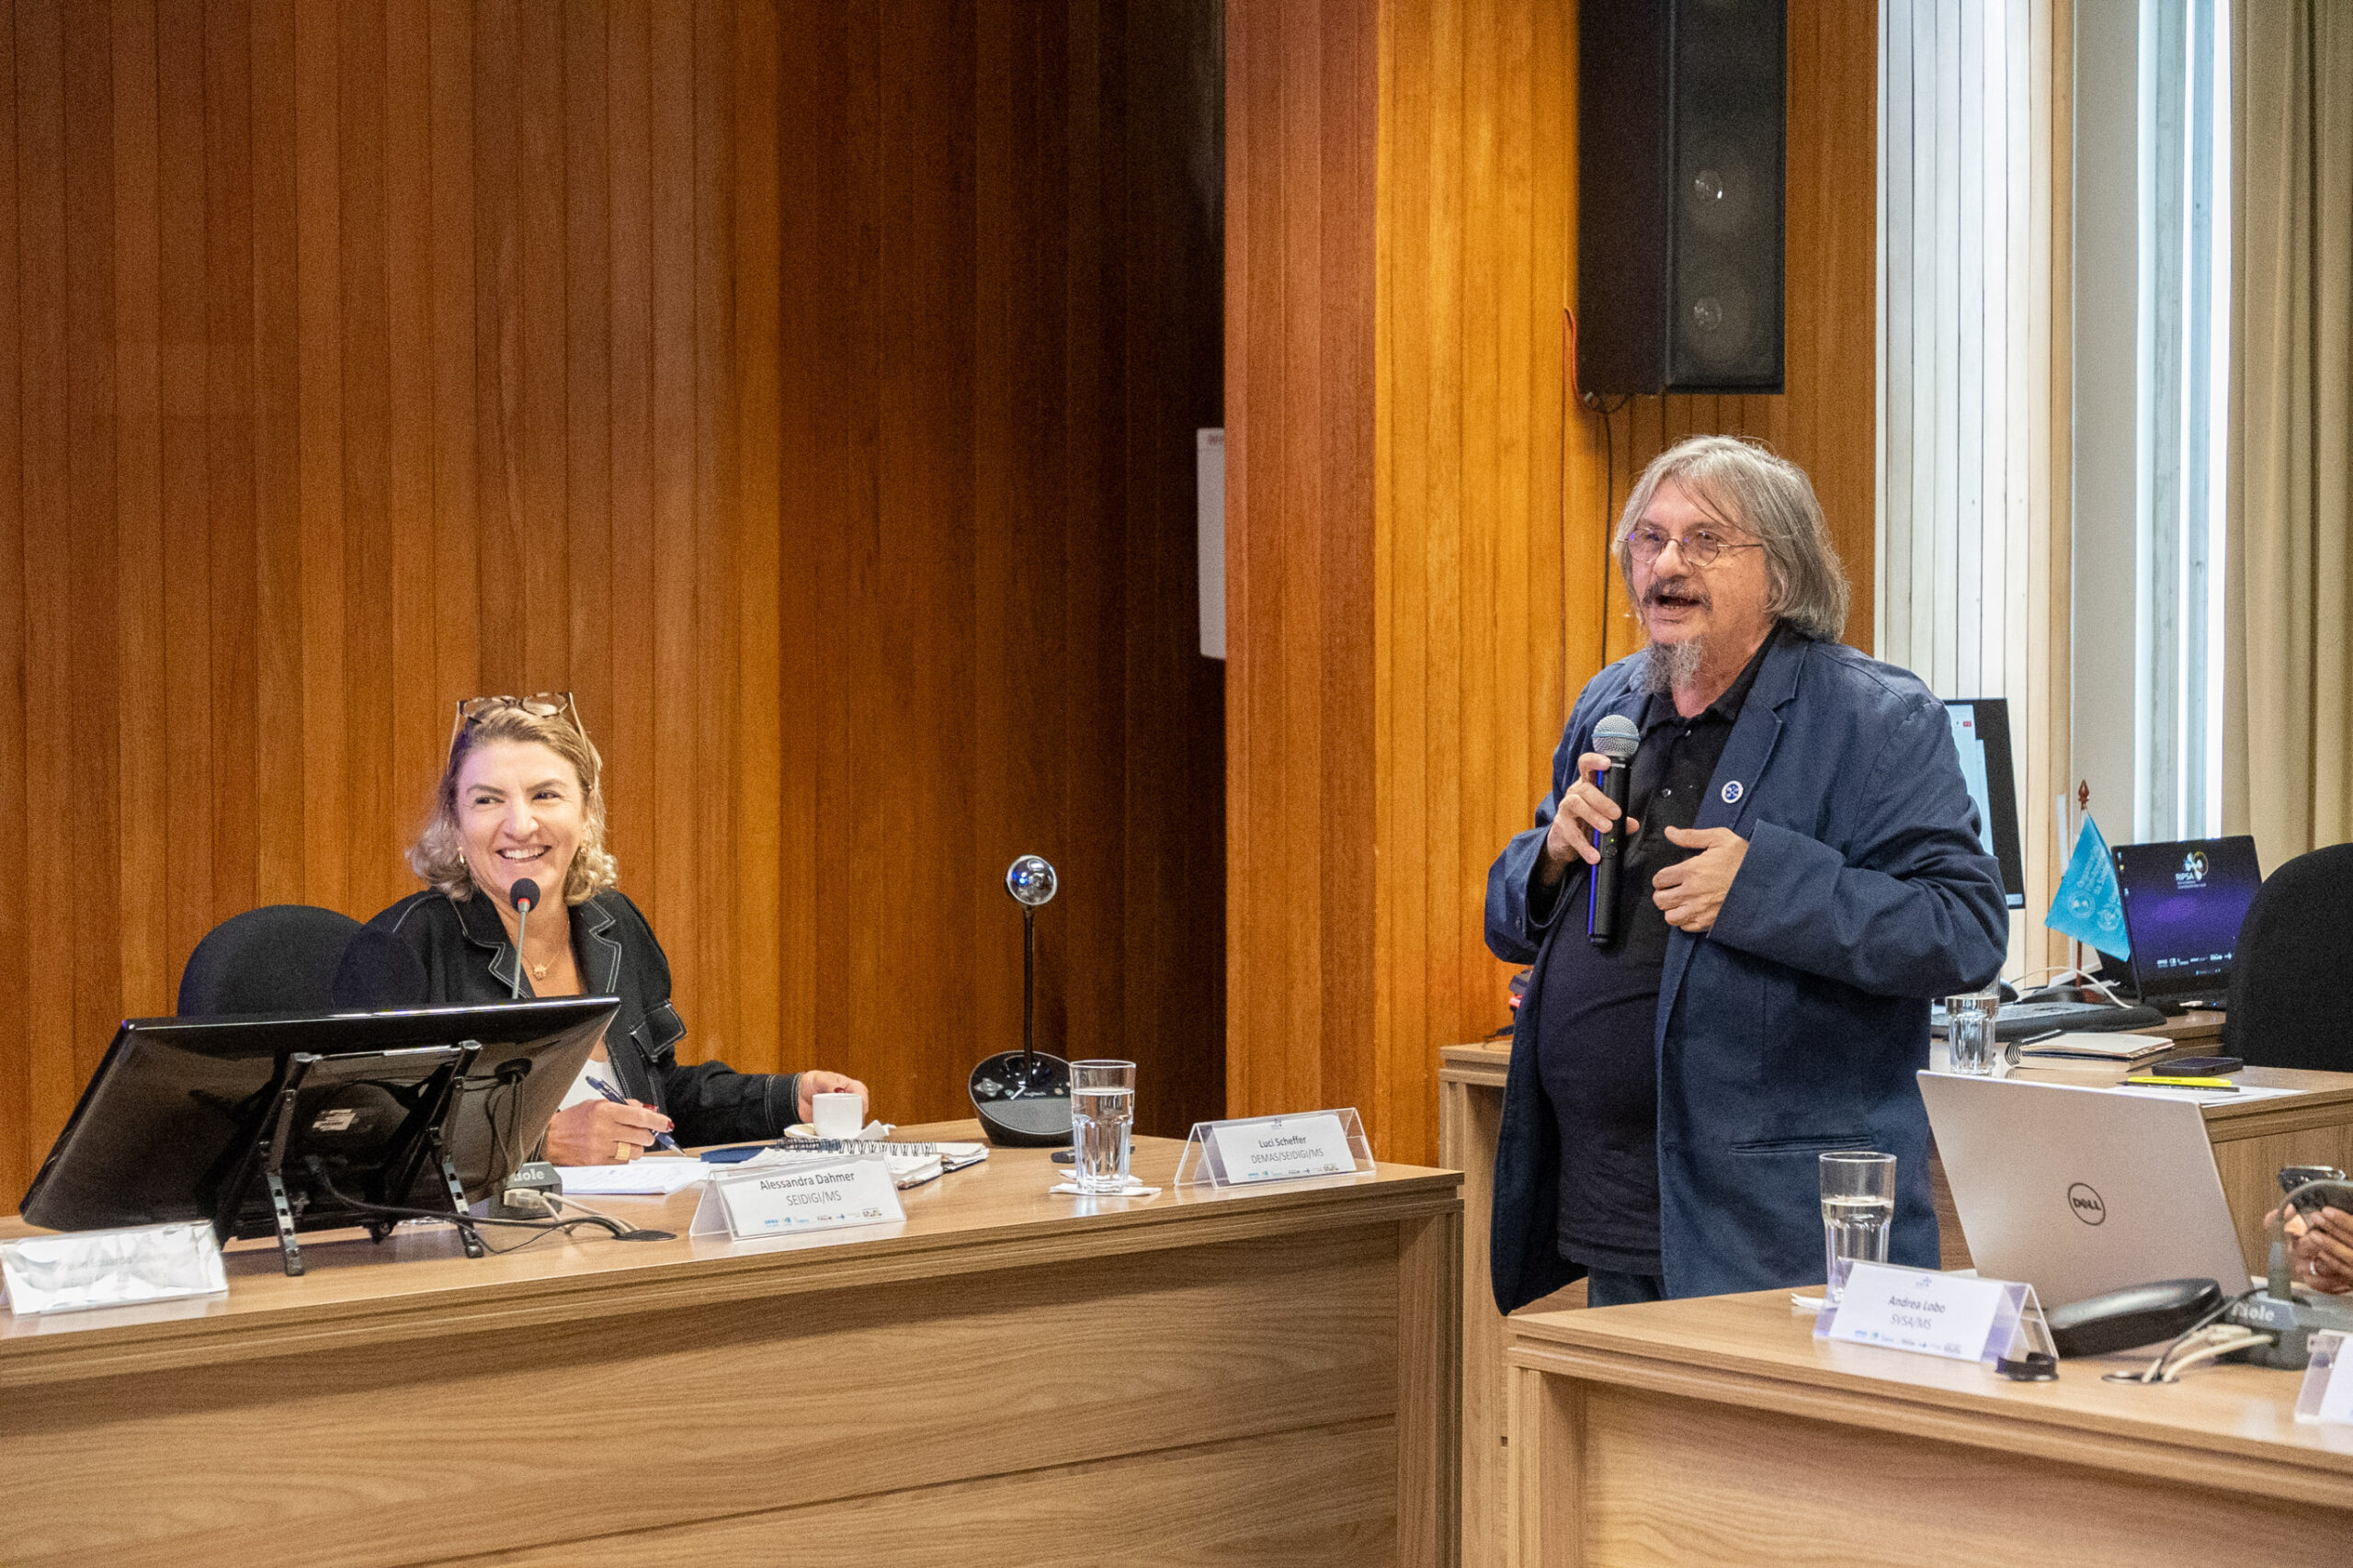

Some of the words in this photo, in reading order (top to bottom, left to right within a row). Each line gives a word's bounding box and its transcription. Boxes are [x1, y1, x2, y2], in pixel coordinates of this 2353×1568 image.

[1258, 1138, 1275, 1148] Luci
[1276, 1135, 1307, 1147] Scheffer
[1250, 1148, 1324, 1165] DEMAS/SEIDIGI/MS
[514, 1168, 545, 1182] iole
[759, 1175, 814, 1191] Alessandra
[817, 1171, 855, 1185] Dahmer
[786, 1190, 842, 1207] SEIDIGI/MS
[2073, 1198, 2102, 1210] DELL
[1888, 1295, 1921, 1310] Andrea
[1923, 1301, 1946, 1313] Lobo
